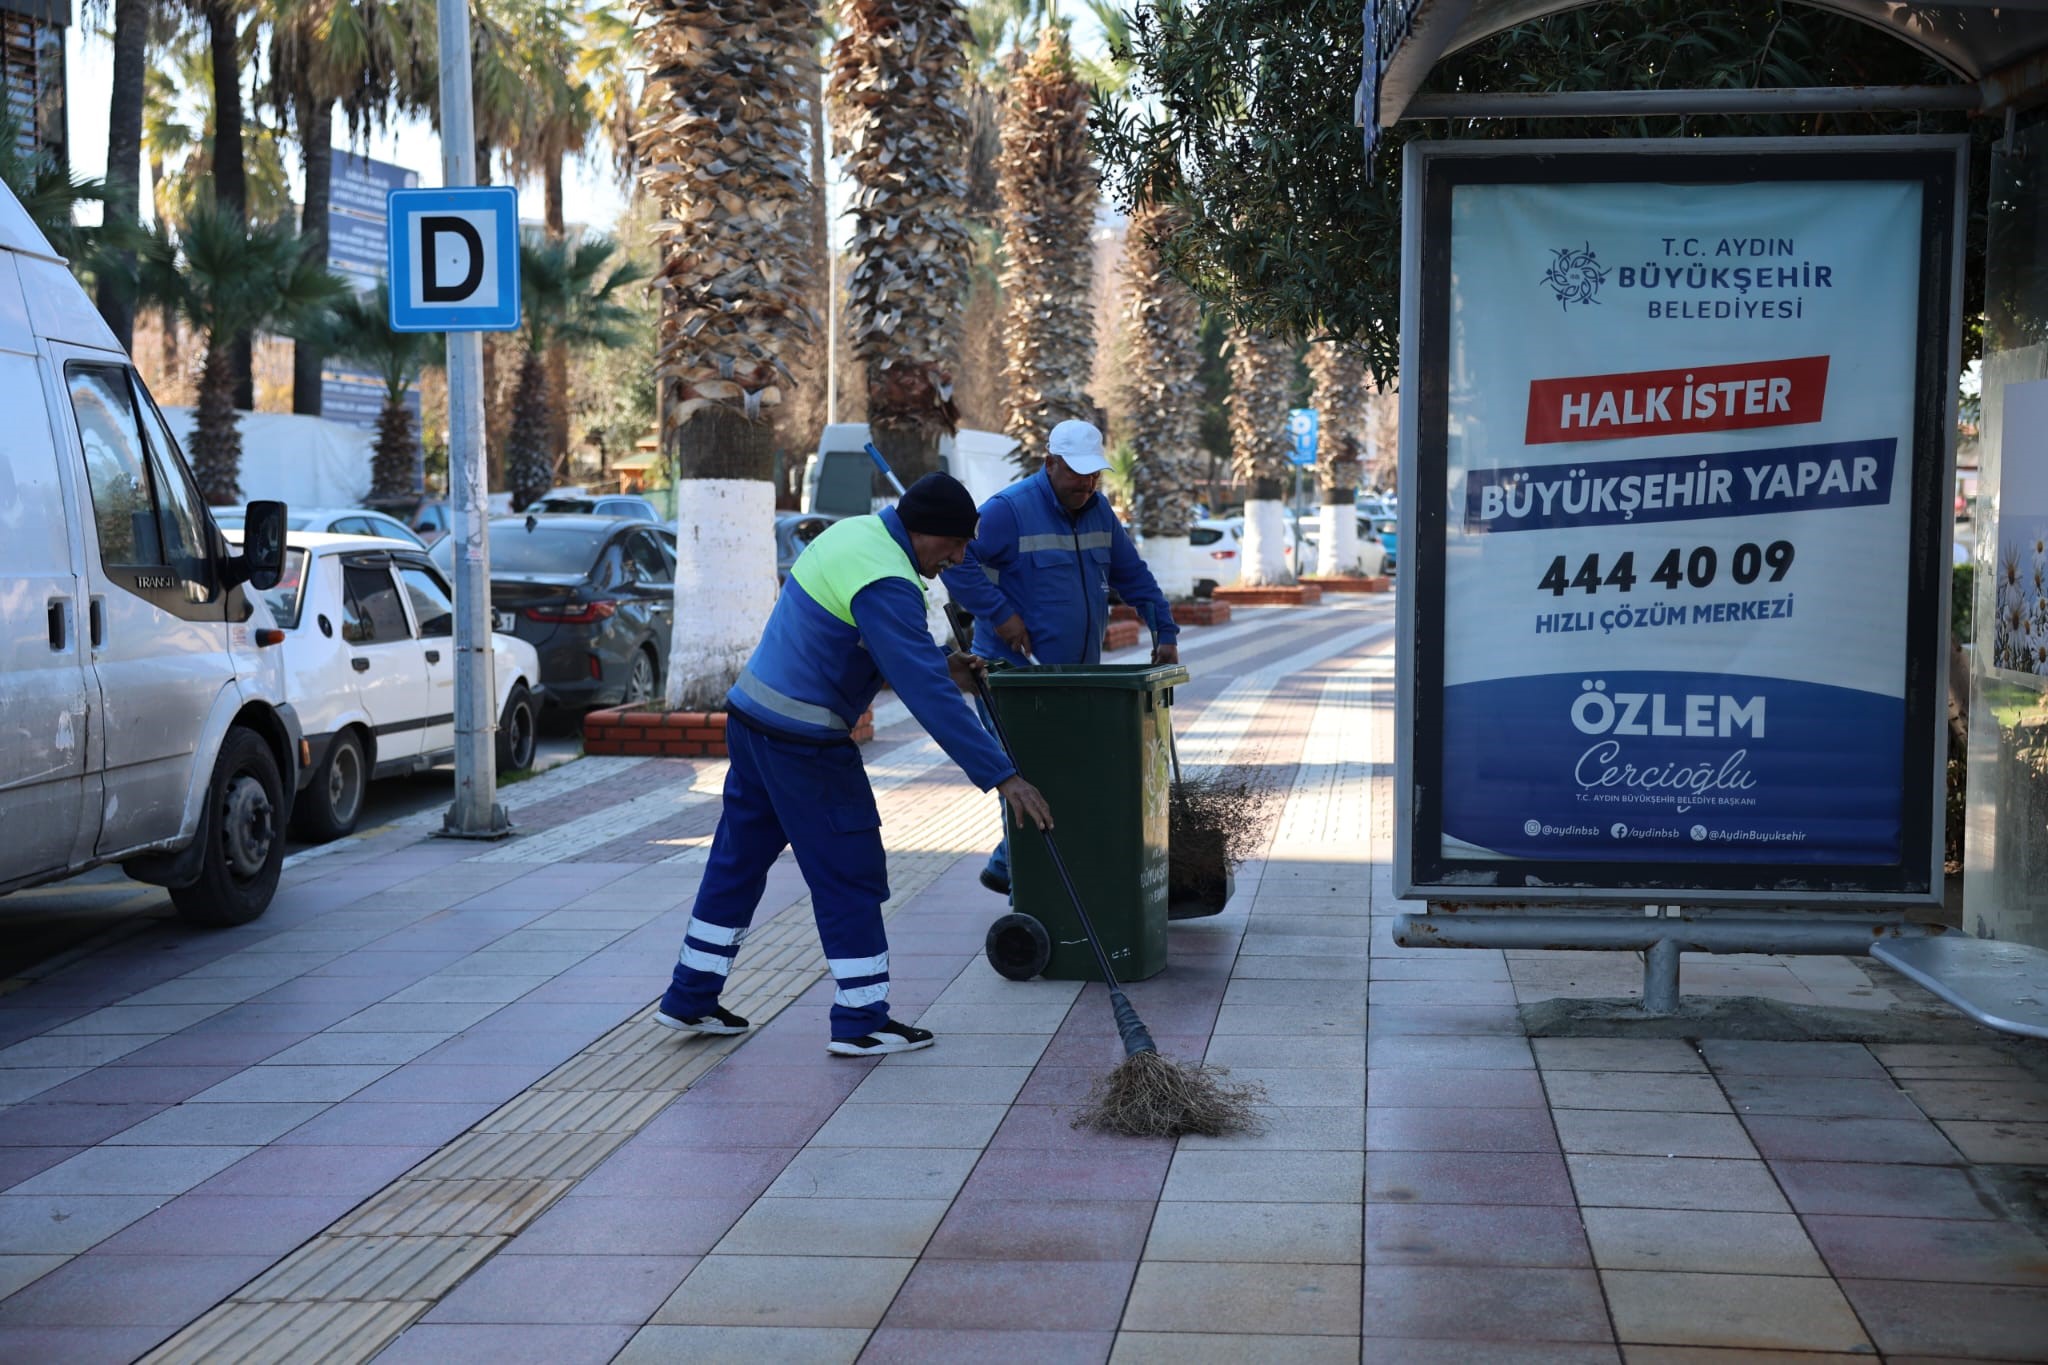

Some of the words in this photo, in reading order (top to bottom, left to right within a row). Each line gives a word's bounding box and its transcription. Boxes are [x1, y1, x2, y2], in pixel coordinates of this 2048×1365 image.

[421, 216, 484, 302] D
[1661, 238, 1706, 257] T.C.
[1715, 238, 1794, 257] AYDIN
[1618, 261, 1833, 294] BÜYÜKŞEHİR
[1648, 297, 1802, 319] BELEDİYESİ
[1560, 386, 1672, 429] HALK
[1682, 374, 1792, 421] İSTER
[1480, 459, 1732, 520] BÜYÜKŞEHİR
[1744, 456, 1878, 501] YAPAR
[1537, 551, 1637, 597] 444
[1650, 546, 1717, 590] 40
[1731, 540, 1796, 585] 09
[1535, 611, 1594, 634] HIZLI
[1600, 602, 1686, 634] ÇÖZÜM
[1692, 592, 1794, 625] MERKEZİ
[1570, 679, 1766, 738] ÖZLEM
[1574, 740, 1757, 813] Çercioğlu
[1593, 793, 1620, 802] AYDIN
[1622, 793, 1676, 805] BÜYÜKŞEHİR
[1677, 794, 1716, 805] BELEDİYE
[1718, 796, 1757, 807] BAŞKANI
[1542, 824, 1600, 838] @aydinbsb
[1708, 829, 1807, 842] @AydinBuyuksehir
